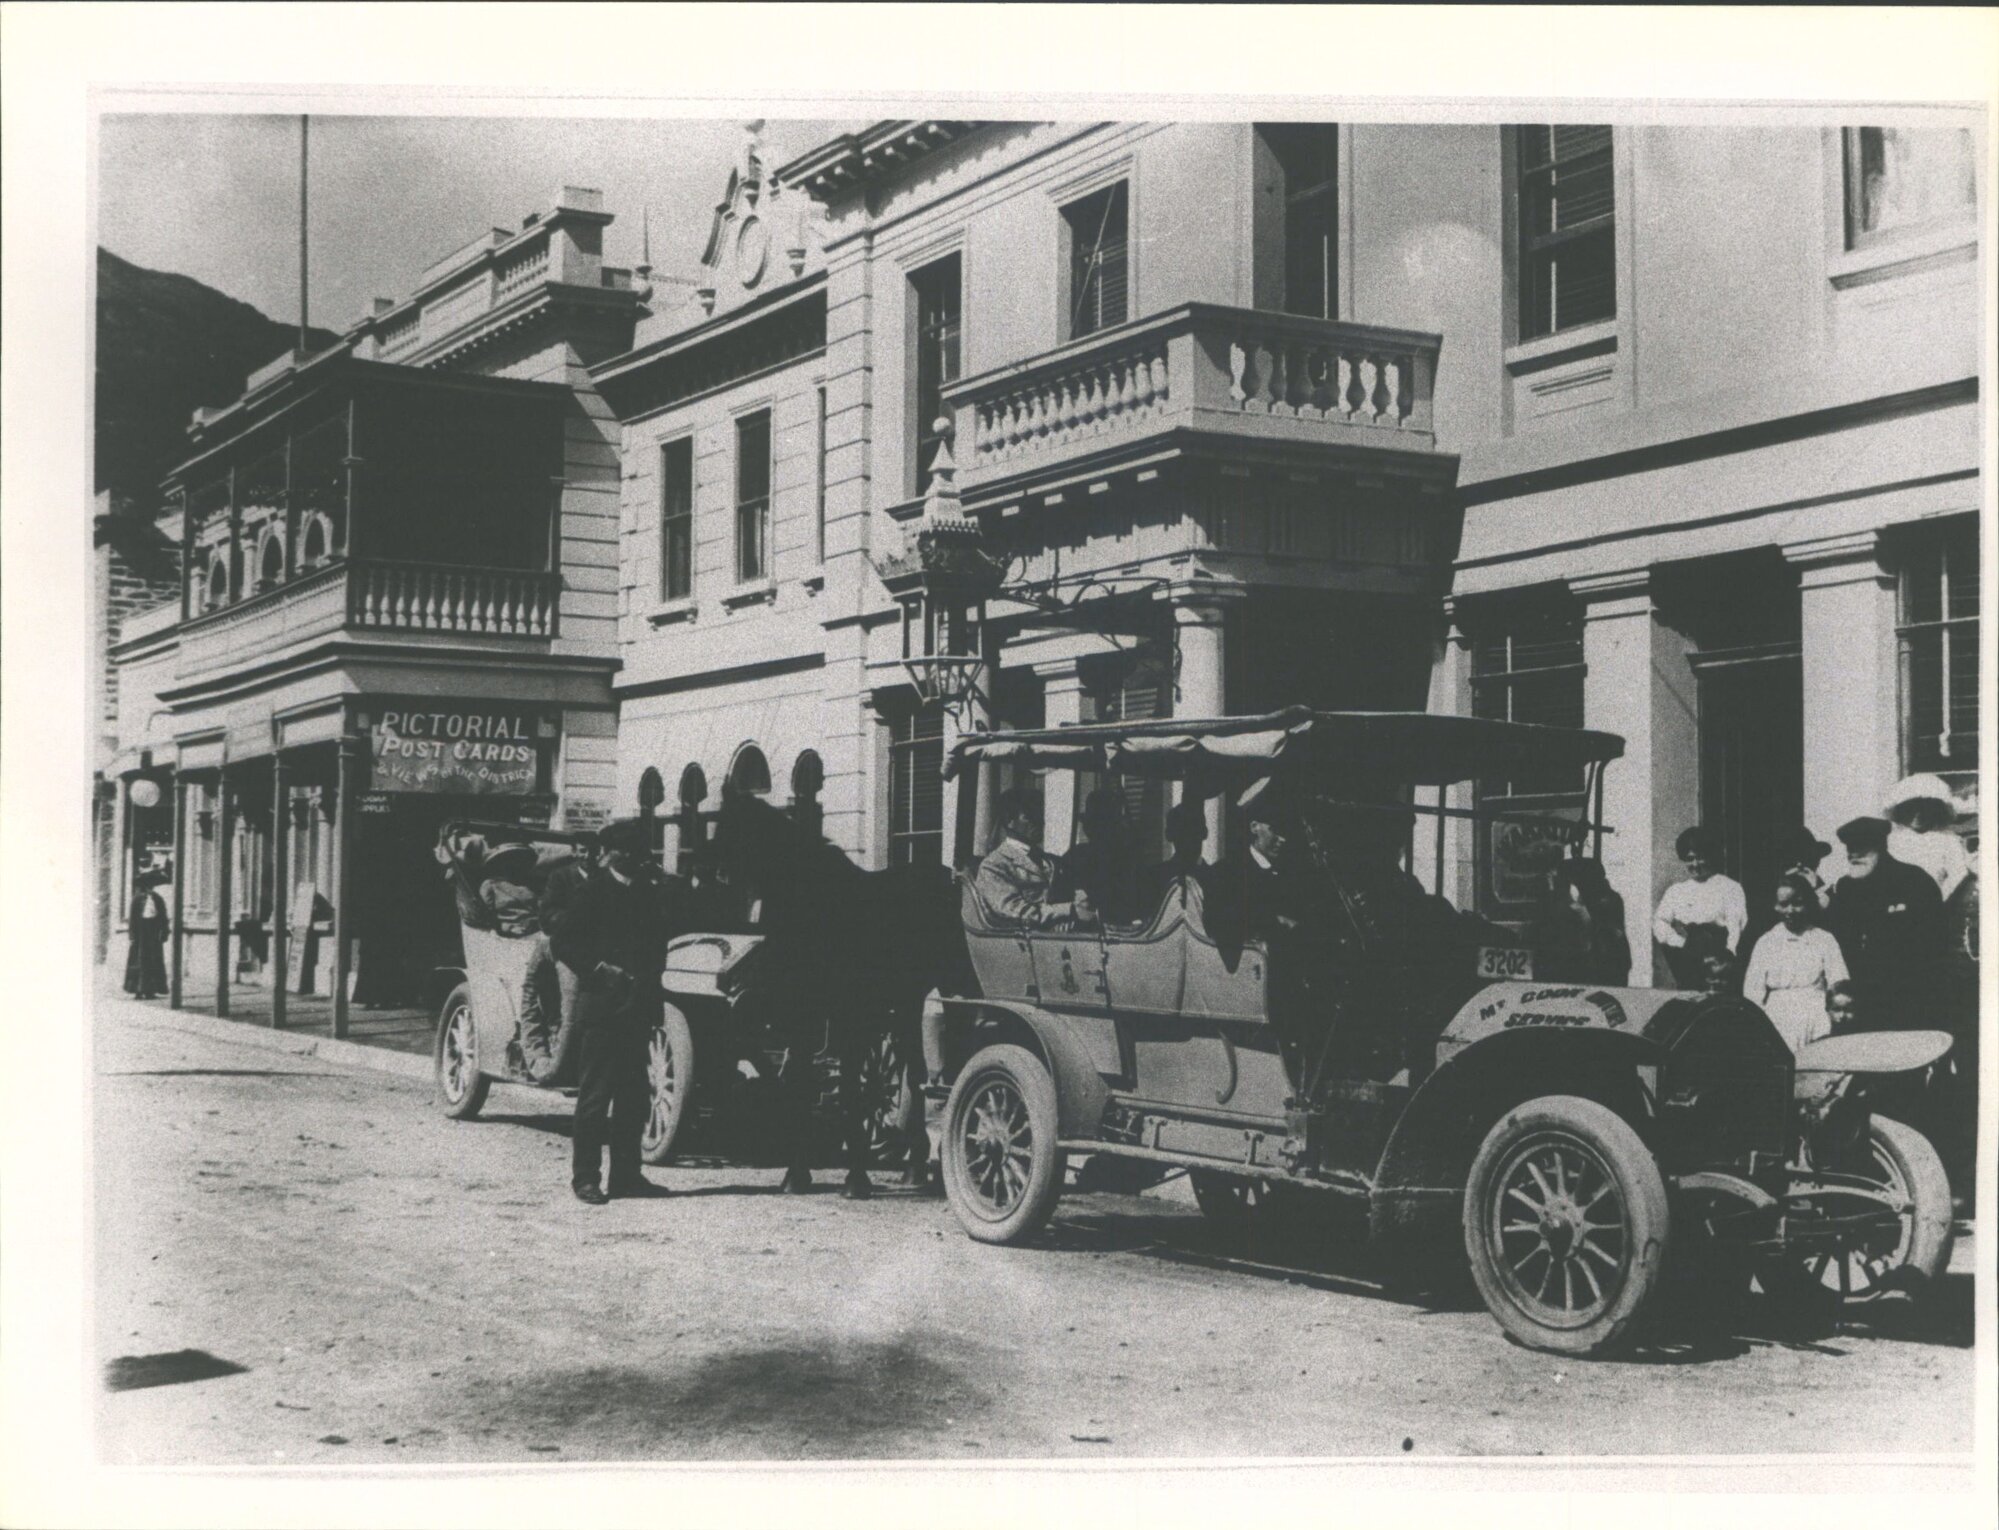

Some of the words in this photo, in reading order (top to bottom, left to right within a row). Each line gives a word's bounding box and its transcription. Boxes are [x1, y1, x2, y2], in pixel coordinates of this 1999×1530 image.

[381, 712, 529, 740] PICTORIAL
[381, 740, 444, 759] POST
[453, 740, 529, 763] CARDS
[391, 762, 438, 783] VIEWS
[1484, 951, 1527, 976] 3202
